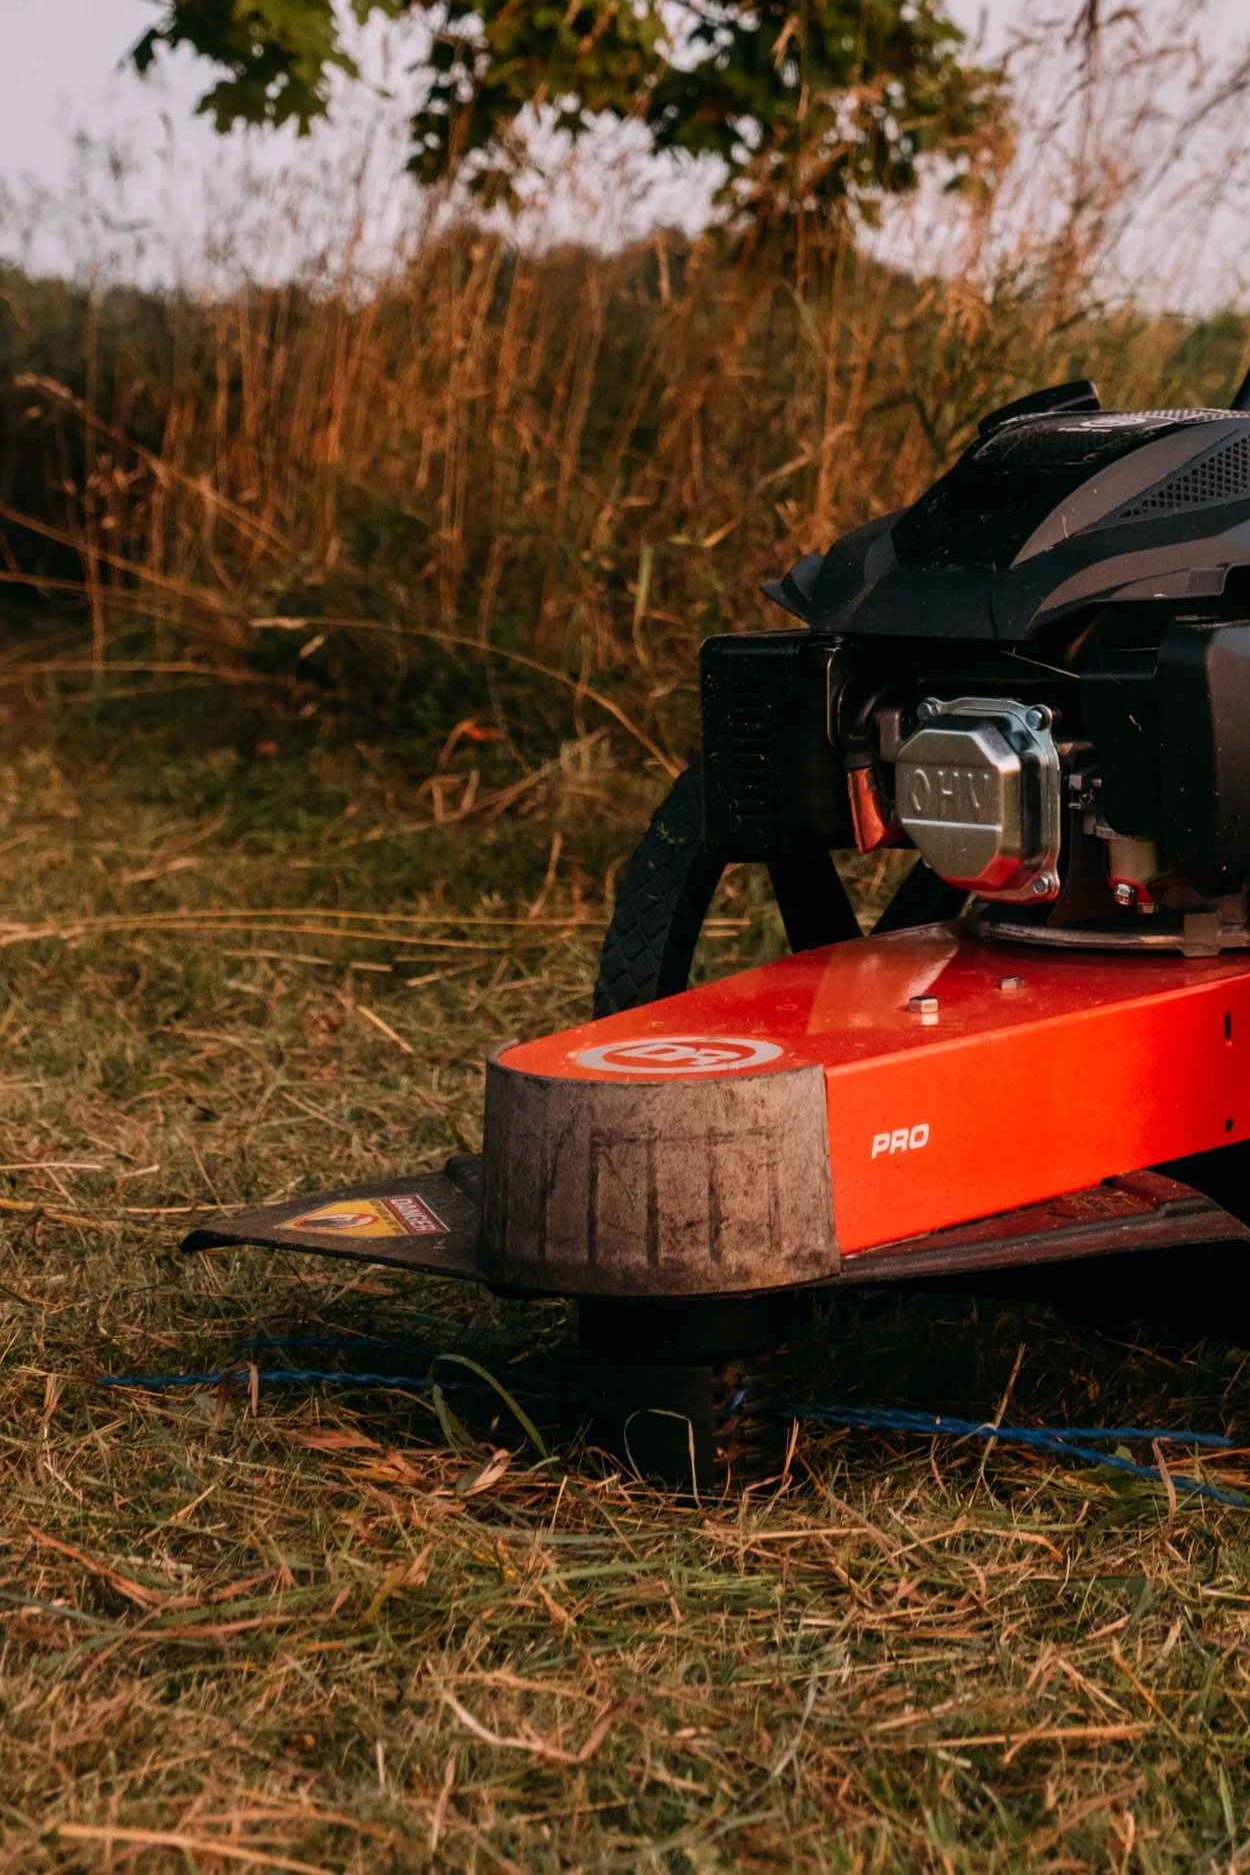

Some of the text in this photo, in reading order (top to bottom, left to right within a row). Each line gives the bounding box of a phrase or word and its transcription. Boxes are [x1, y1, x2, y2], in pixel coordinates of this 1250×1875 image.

[908, 767, 991, 819] OHV
[871, 1123, 930, 1159] PRO
[390, 1198, 437, 1232] DANGER
